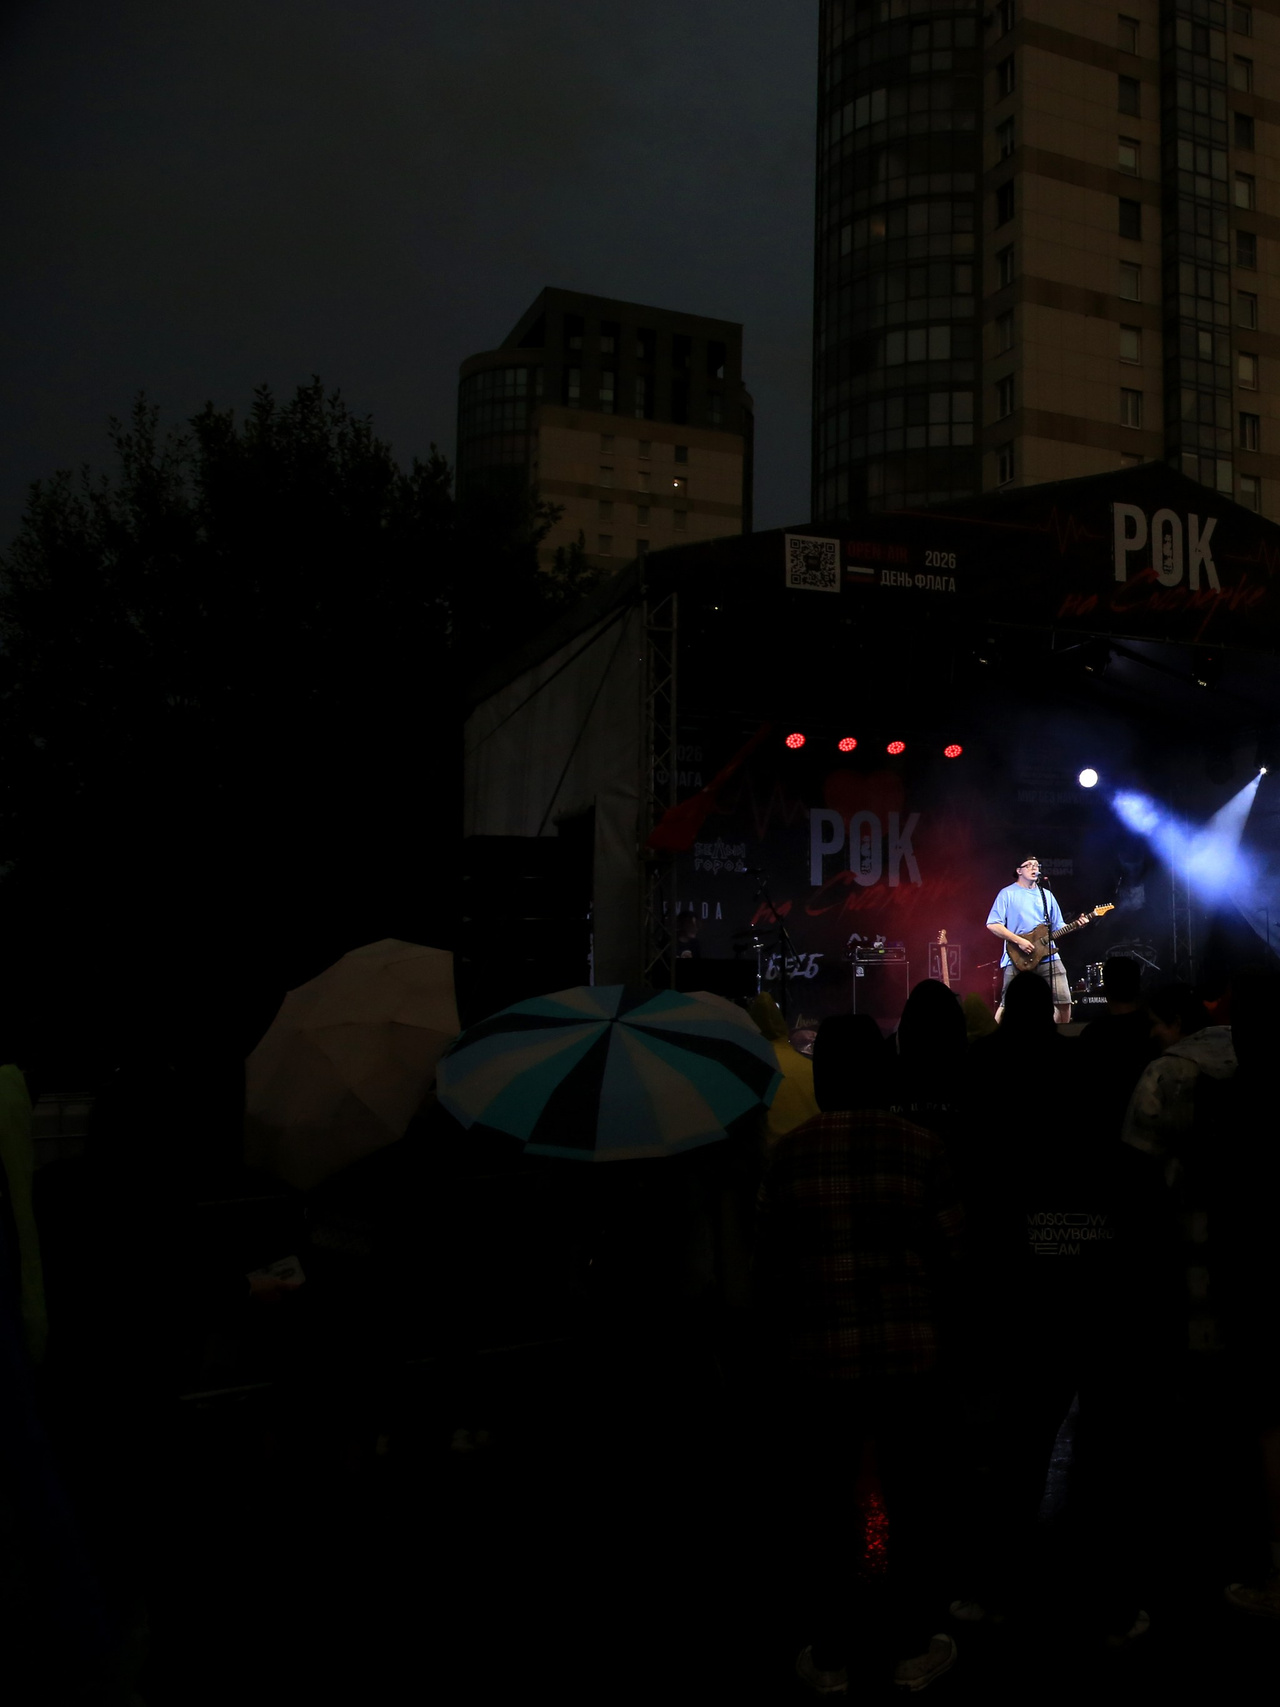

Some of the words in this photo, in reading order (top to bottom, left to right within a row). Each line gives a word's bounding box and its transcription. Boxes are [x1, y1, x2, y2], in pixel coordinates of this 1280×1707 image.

[1112, 502, 1221, 594] РОК
[925, 550, 956, 569] 2026
[880, 570, 912, 588] ДЕНЬ
[915, 574, 956, 592] ФЛАГА
[677, 744, 703, 762] 026
[656, 770, 703, 787] ФАГА
[810, 808, 923, 887] РОК
[1088, 996, 1108, 1004] YAMAHA
[1026, 1212, 1108, 1226] MOSCOW
[1027, 1227, 1115, 1240] SNOWBOARD
[1028, 1241, 1080, 1256] TEAM
